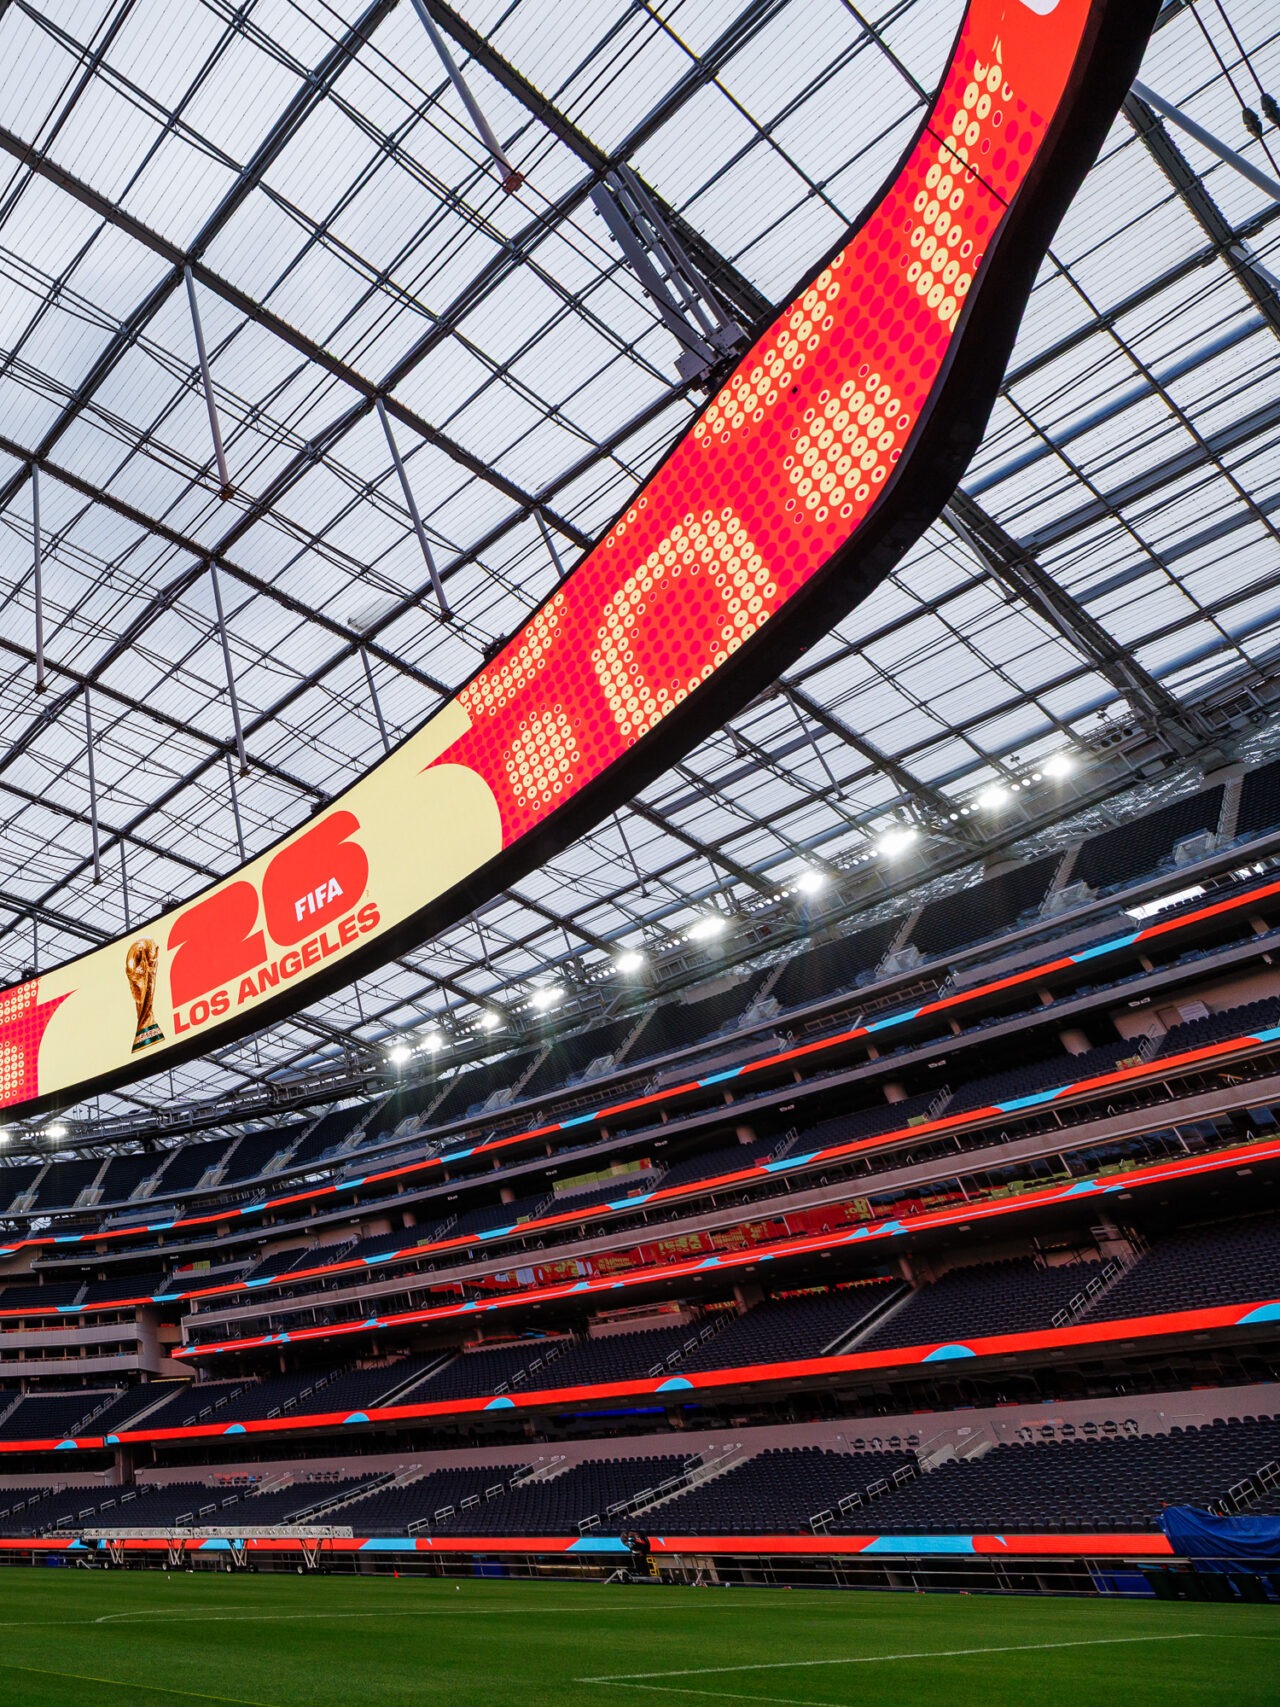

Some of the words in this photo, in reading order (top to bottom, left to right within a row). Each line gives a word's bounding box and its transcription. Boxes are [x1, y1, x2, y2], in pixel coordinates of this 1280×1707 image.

[167, 810, 369, 1010] 26
[294, 877, 344, 922] FIFA
[173, 990, 231, 1035] LOS
[237, 902, 381, 1005] ANGELES
